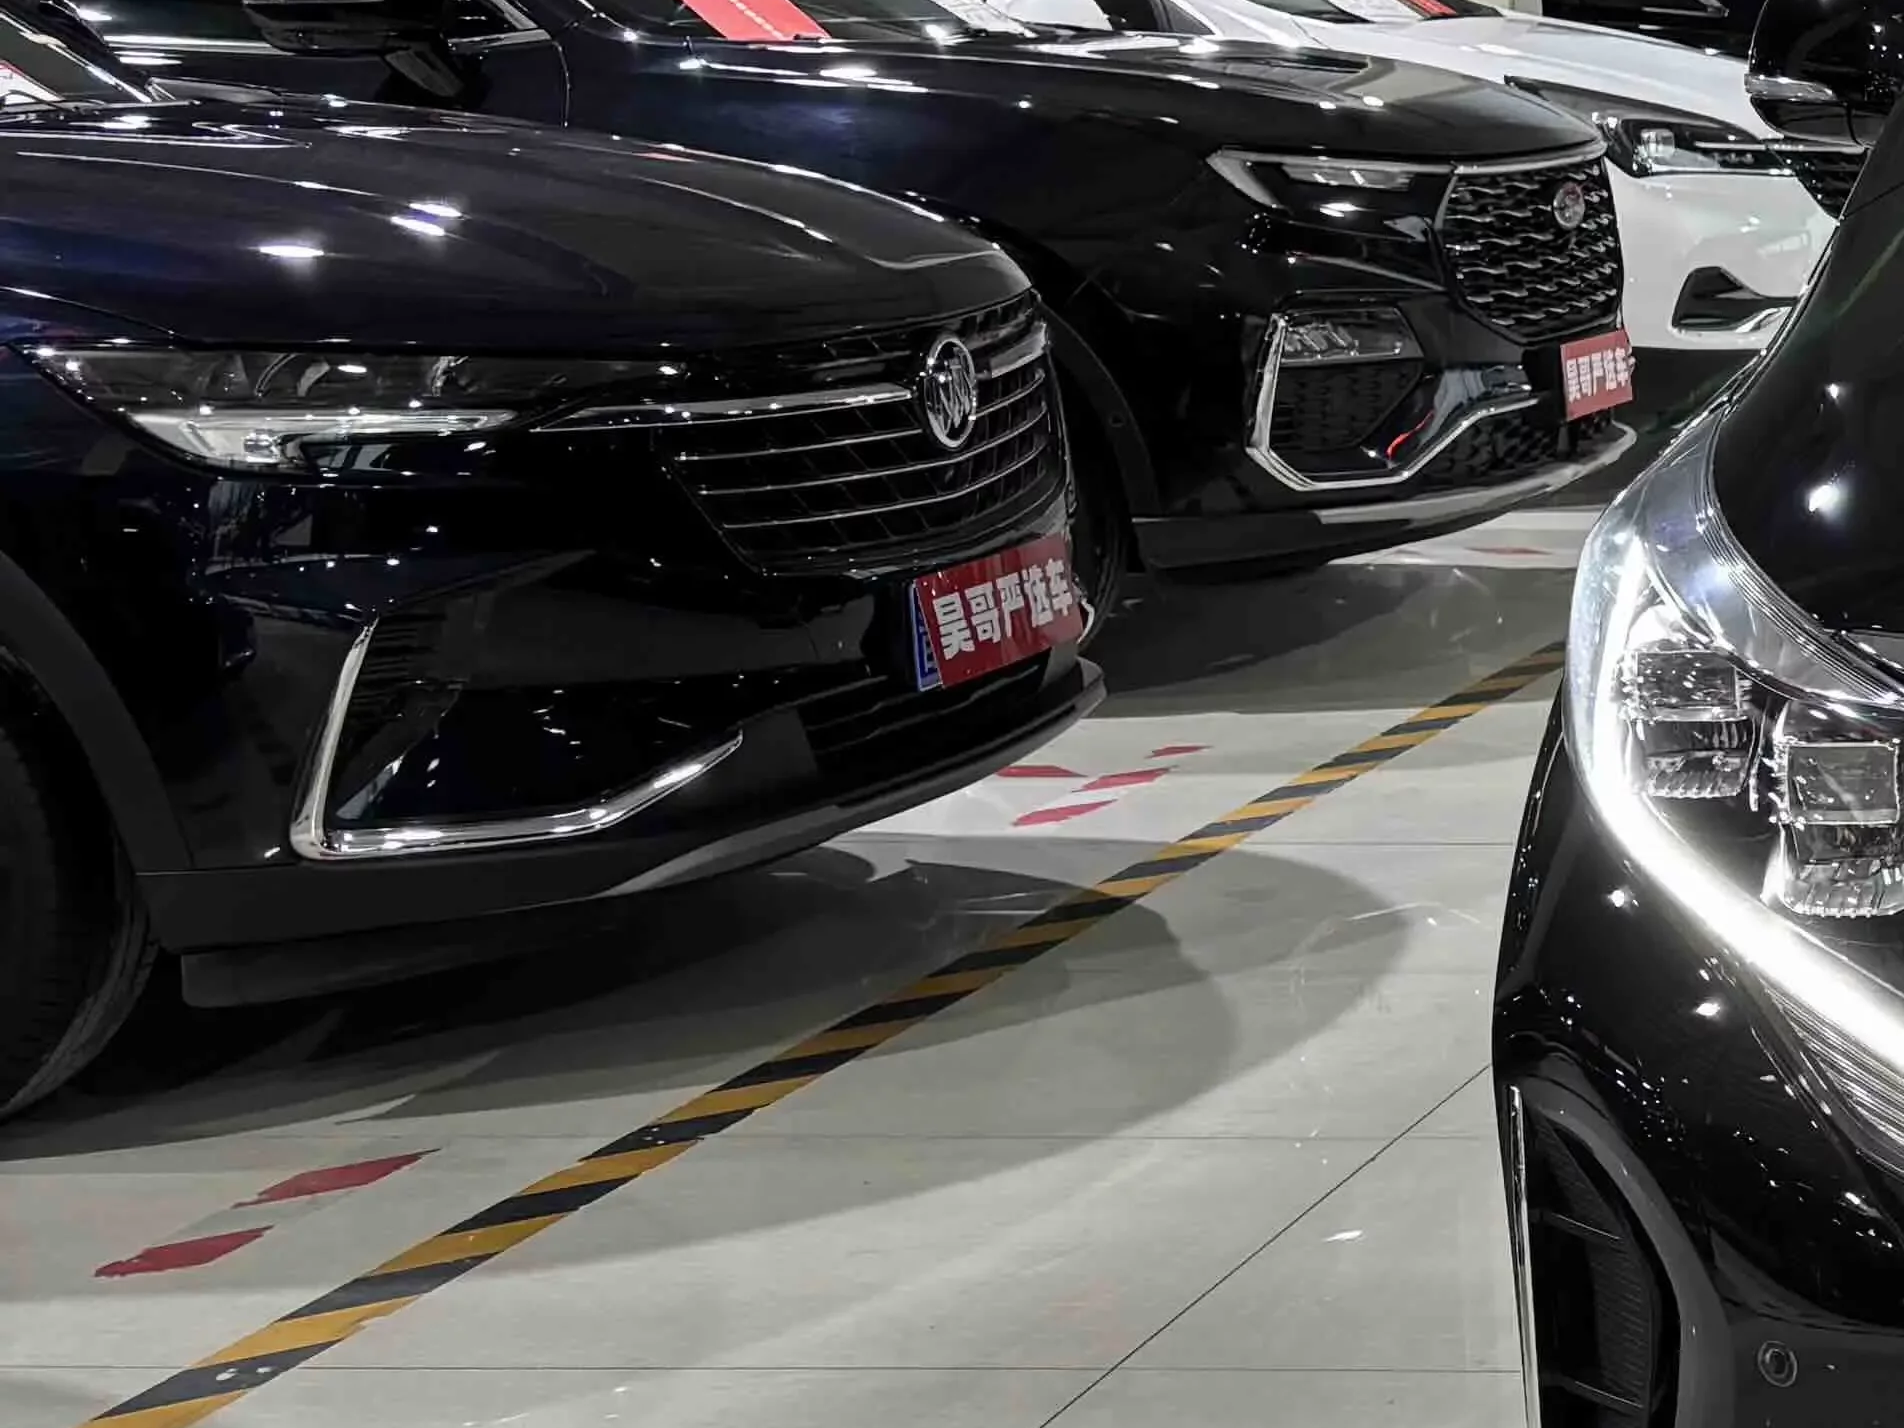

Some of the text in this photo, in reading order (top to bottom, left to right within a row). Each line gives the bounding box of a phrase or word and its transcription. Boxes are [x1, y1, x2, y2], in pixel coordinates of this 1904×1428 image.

[932, 558, 1073, 661] 昊哥严选车
